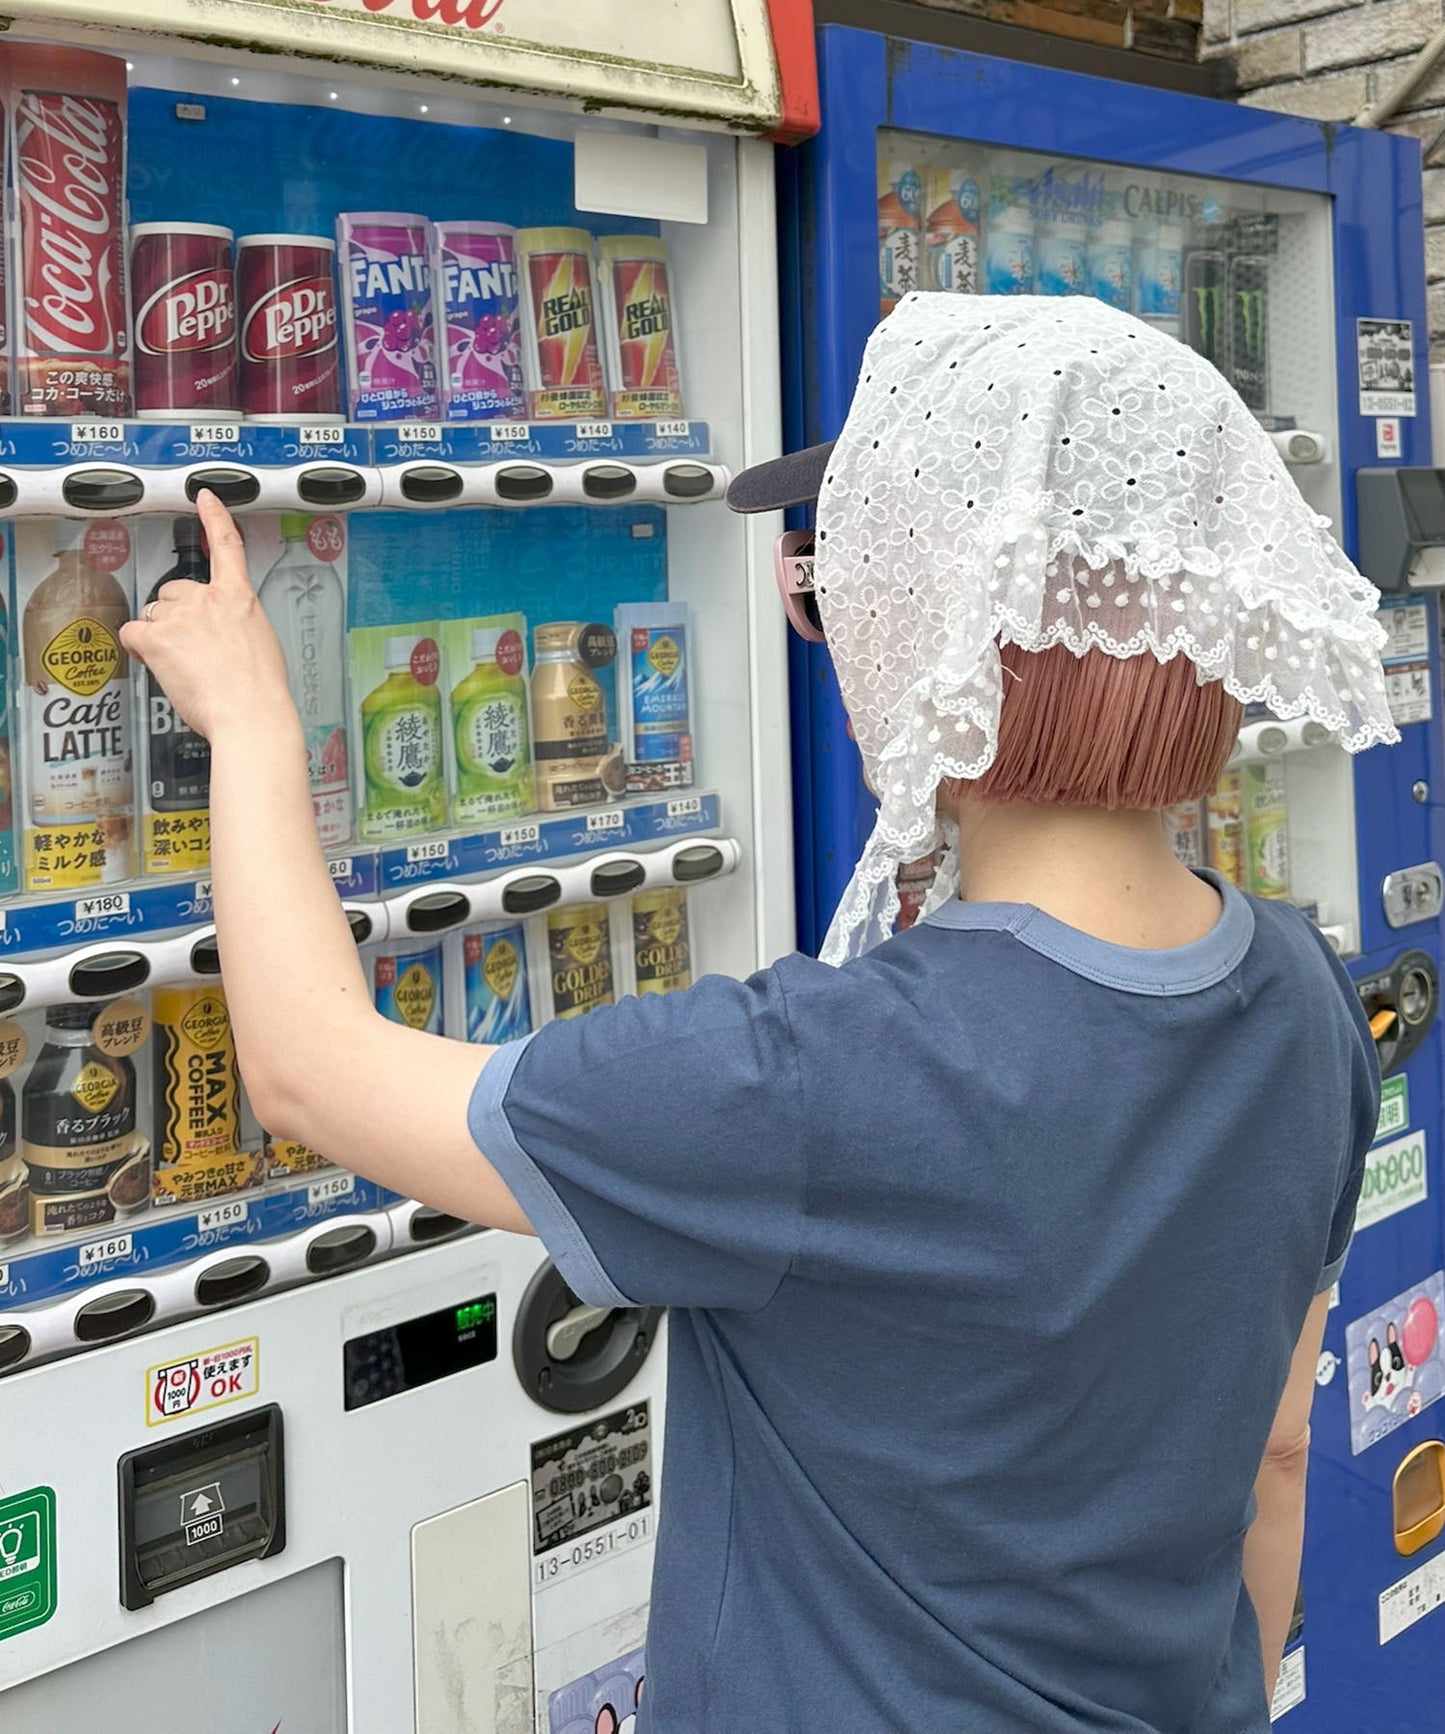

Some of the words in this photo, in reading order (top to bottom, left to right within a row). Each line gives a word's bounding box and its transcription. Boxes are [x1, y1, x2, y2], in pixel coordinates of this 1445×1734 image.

[1122, 184, 1199, 219] CALPIS
[18, 93, 109, 354] Coca-Cola
[895, 231, 915, 293] 麦茶
[955, 238, 975, 294] 麦茶
[195, 280, 230, 313] Dr
[292, 288, 326, 321] Dr
[543, 287, 588, 318] REAL
[626, 293, 667, 321] REAL
[166, 292, 235, 343] Peppe
[264, 301, 337, 351] Peppe
[46, 371, 114, 385] この爽快感
[31, 387, 125, 402] コカ・コーラだけ
[77, 426, 119, 439] ¥160
[194, 427, 234, 440] ¥150
[304, 430, 340, 441] ¥150
[403, 427, 436, 439] ¥150
[495, 428, 525, 438] ¥150
[579, 425, 609, 435] ¥140
[659, 424, 686, 434] ¥140
[49, 649, 118, 666] GEORGIA
[65, 664, 107, 681] Coffee
[43, 690, 122, 729] Café
[483, 701, 510, 758] 綾鷹
[43, 726, 123, 763] LATTE
[395, 713, 423, 772] 綾鷹
[671, 799, 698, 813] ¥140
[590, 813, 619, 827] ¥170
[34, 829, 106, 852] 軽やかな
[504, 827, 536, 842] ¥150
[38, 849, 107, 872] ミルク感
[411, 843, 445, 858] ¥150
[329, 861, 347, 875] 60
[83, 895, 124, 914] ¥180
[102, 1016, 144, 1038] 高級豆
[103, 1031, 141, 1048] ブレンド
[75, 1078, 118, 1094] GEORGIA
[187, 1054, 205, 1130] COFFEE
[205, 1050, 228, 1127] MAX
[57, 1107, 129, 1135] 香るブラック
[172, 1160, 246, 1185] やみつきの甘さ
[181, 1174, 238, 1197] 元気MAX
[312, 1178, 349, 1198] ¥150
[202, 1204, 242, 1226] ¥150
[85, 1239, 127, 1261] ¥160
[203, 1354, 253, 1380] 使えます
[167, 1387, 187, 1400] 1000
[210, 1372, 243, 1398] OK
[173, 1400, 181, 1409] 円
[191, 1519, 218, 1539] 1000
[538, 1518, 648, 1581] 13-0551-01
[0, 1562, 28, 1578] ED照明
